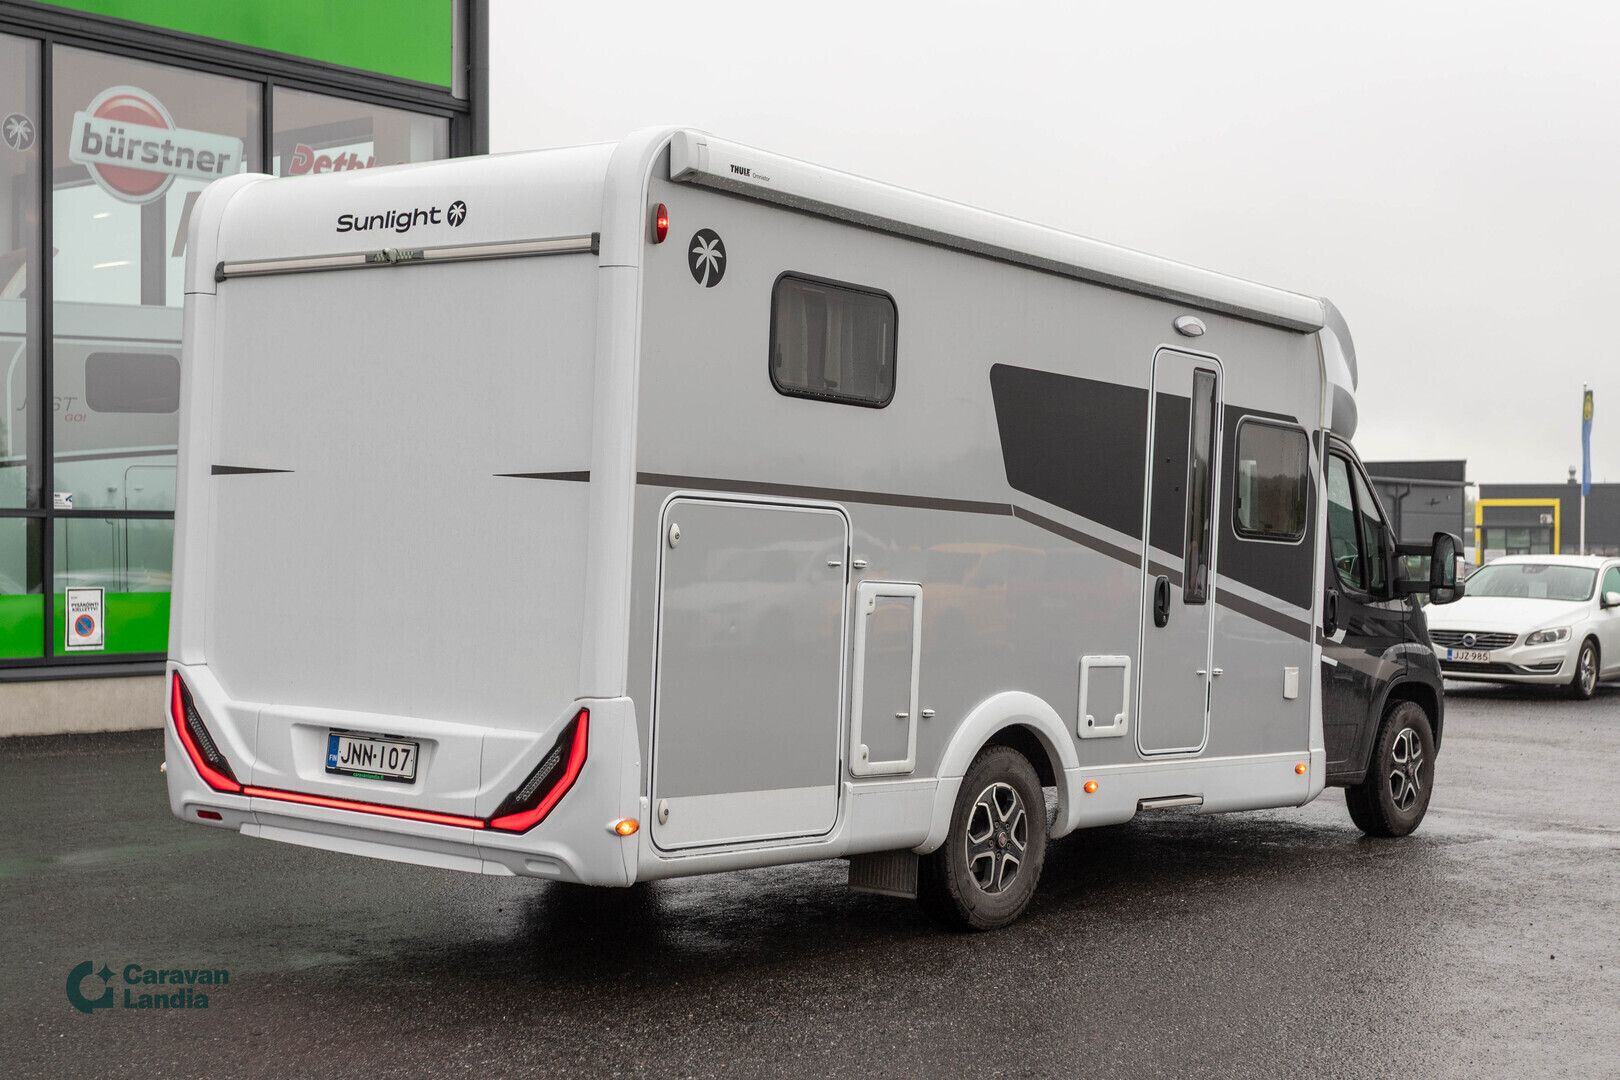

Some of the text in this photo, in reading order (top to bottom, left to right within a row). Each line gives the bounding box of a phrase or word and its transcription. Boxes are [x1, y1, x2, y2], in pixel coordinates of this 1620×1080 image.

[81, 122, 231, 174] bürstner
[730, 164, 751, 177] THULE
[336, 206, 442, 233] Sunlight
[340, 741, 411, 771] JNN-107
